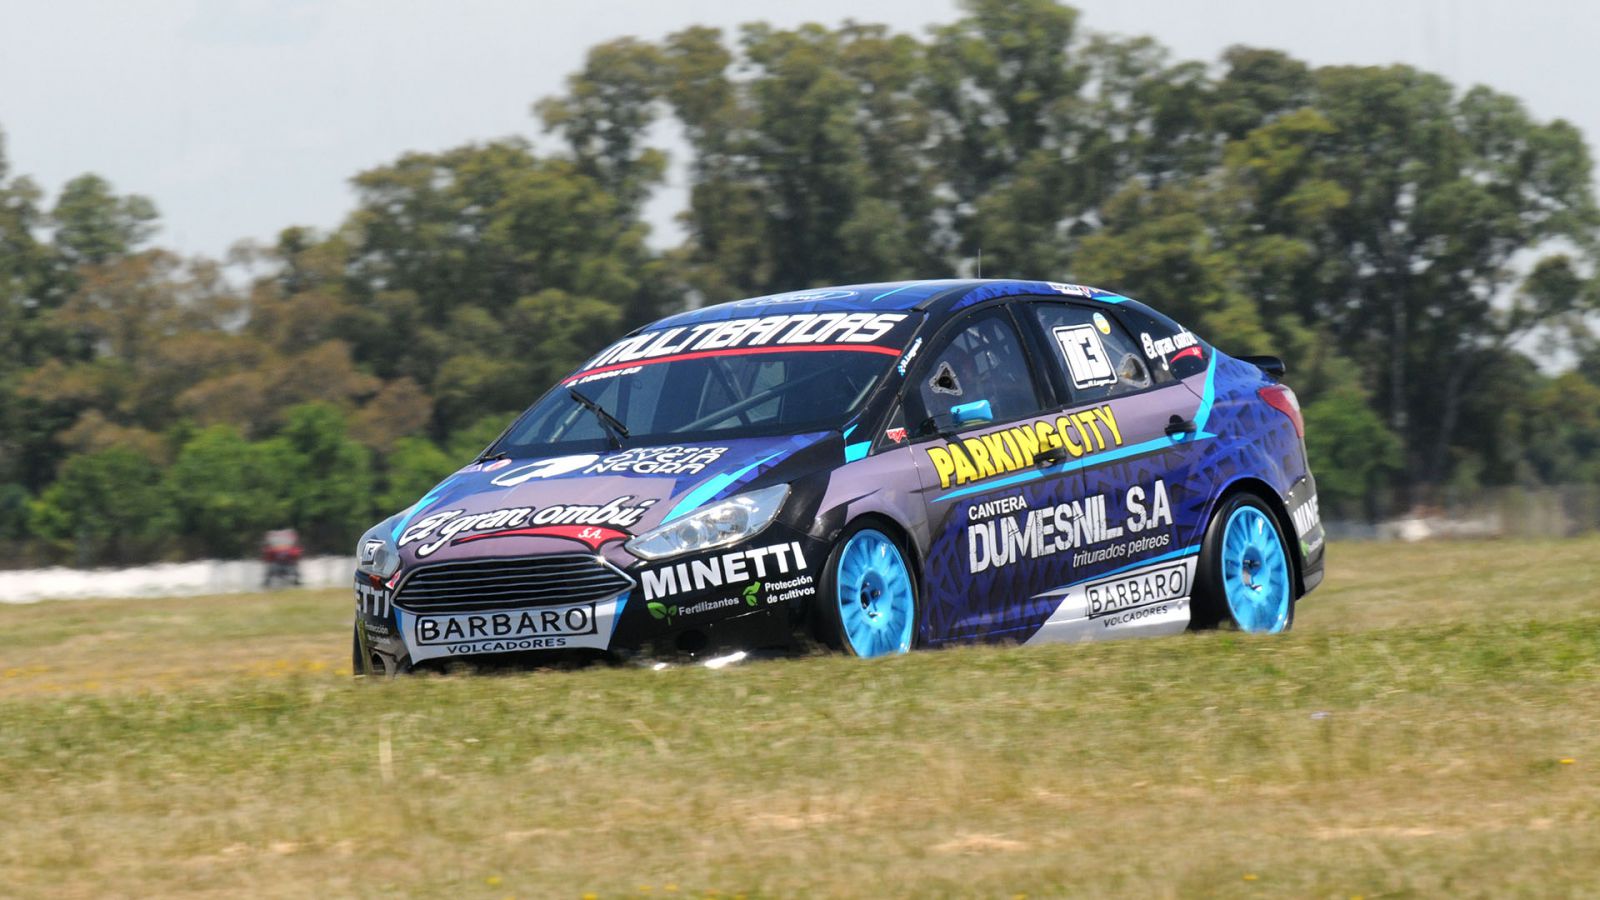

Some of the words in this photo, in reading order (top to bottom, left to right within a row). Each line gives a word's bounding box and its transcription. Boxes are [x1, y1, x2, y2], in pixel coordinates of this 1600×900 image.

[584, 313, 908, 370] MULTIBANDAS
[968, 495, 1027, 520] CANTERA
[398, 509, 465, 546] El
[417, 507, 533, 556] gran
[968, 494, 1123, 574] DUMESNIL
[1127, 480, 1173, 532] S.A
[1073, 543, 1126, 568] triturados
[1127, 534, 1169, 558] petreos
[641, 541, 807, 600] MINETTI
[764, 575, 813, 592] Protección
[678, 596, 739, 616] Fertilizantes
[767, 594, 778, 604] de
[779, 586, 815, 601] cultivos
[1089, 570, 1183, 613] BARBARO
[420, 607, 588, 641] BARBARO
[1103, 605, 1168, 628] VOLCADORES
[447, 638, 567, 655] VOLCADORES
